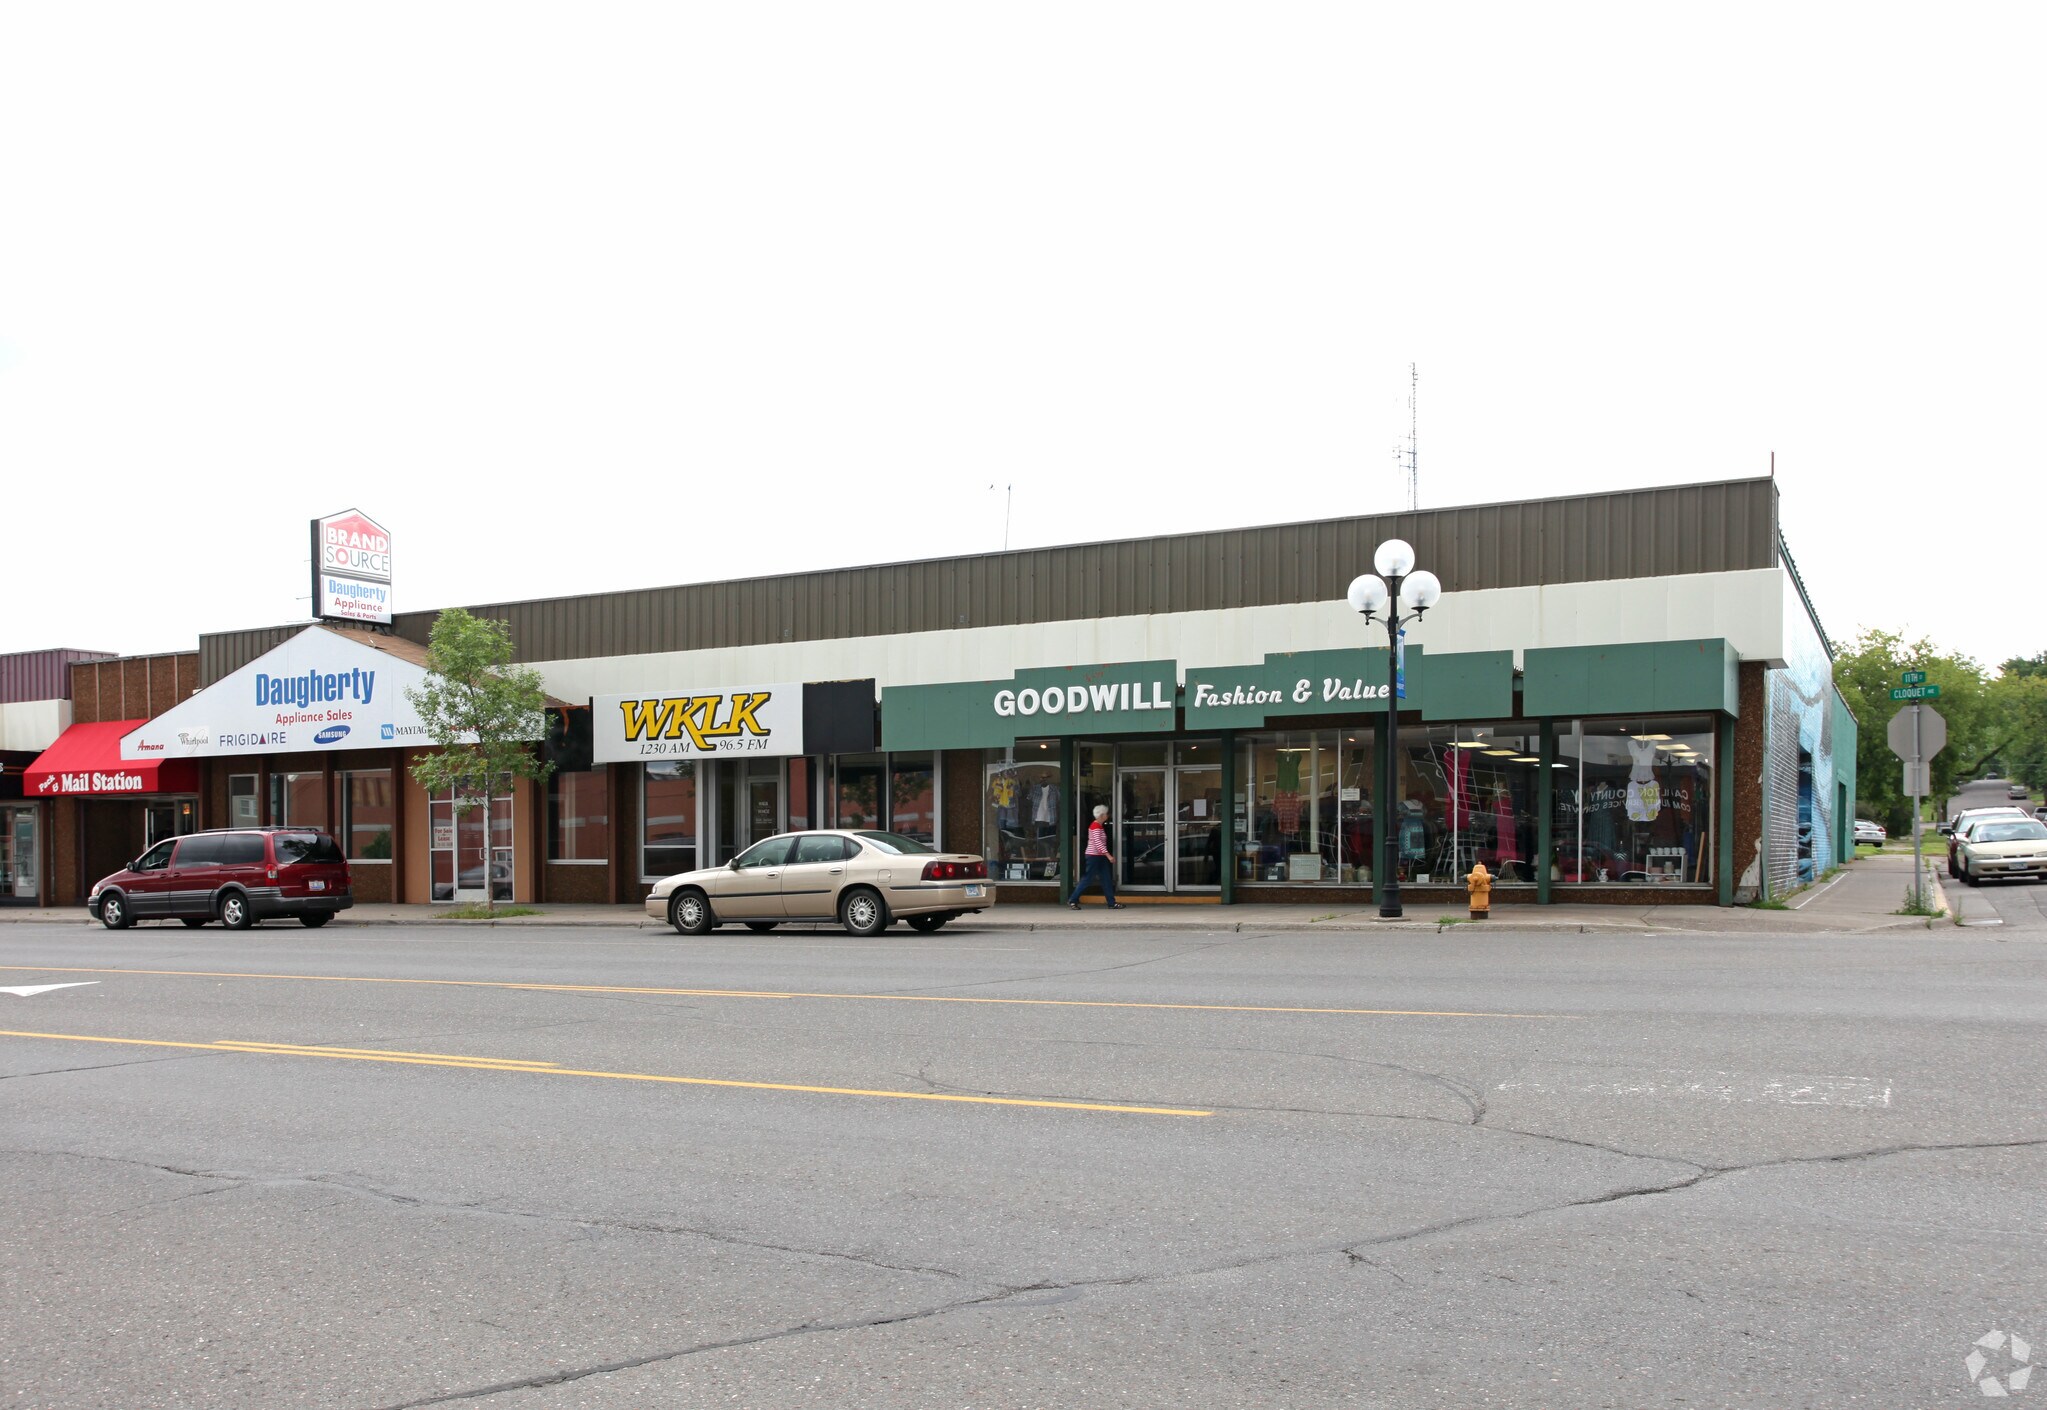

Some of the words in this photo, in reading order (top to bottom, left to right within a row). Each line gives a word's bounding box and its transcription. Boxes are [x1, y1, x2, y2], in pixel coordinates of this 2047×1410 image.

[327, 526, 388, 552] BRAND
[326, 545, 389, 572] SOURCE
[329, 579, 386, 603] Daugherty
[335, 597, 382, 612] Appliance
[340, 610, 355, 618] Sales
[363, 612, 377, 620] Parts
[1904, 673, 1918, 683] 11TH
[256, 667, 376, 708] Daugherty
[1194, 684, 1283, 708] Fashion
[1292, 679, 1312, 704] &
[1322, 679, 1390, 702] Value
[1893, 687, 1926, 699] CLOQUET
[994, 681, 1172, 716] GOODWILL
[275, 712, 324, 726] Appliance
[326, 710, 353, 722] Sales
[620, 692, 772, 751] WKLK
[318, 729, 347, 740] SAMSUNG
[395, 725, 427, 736] MAYTAG
[137, 739, 164, 751] Amana
[180, 732, 209, 749] Whirlpool
[220, 731, 287, 746] FRIGIDAIRE
[719, 739, 743, 751] 96.5
[747, 738, 768, 750] FM
[640, 743, 667, 755] 1230
[669, 742, 690, 753] AM
[38, 774, 55, 792] Pack
[61, 773, 90, 792] Mail
[92, 771, 142, 791] Station
